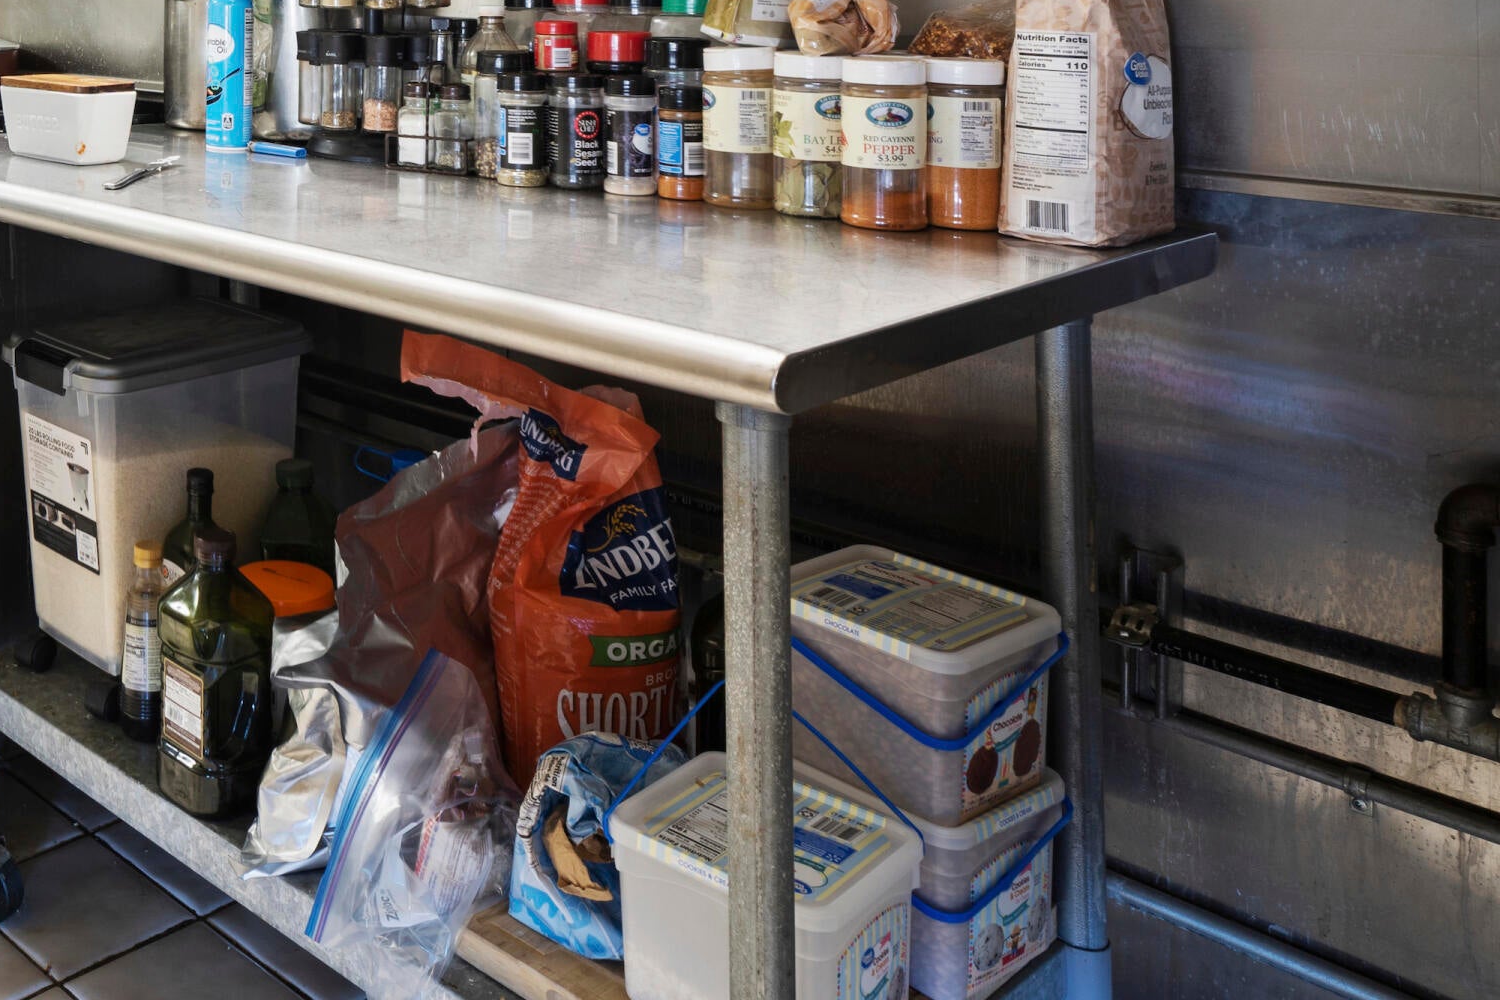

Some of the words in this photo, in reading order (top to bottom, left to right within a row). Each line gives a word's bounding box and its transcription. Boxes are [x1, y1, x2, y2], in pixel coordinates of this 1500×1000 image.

[1016, 33, 1056, 43] Nutrition
[1058, 35, 1088, 44] Facts
[1017, 60, 1046, 68] Calories
[1066, 61, 1088, 70] 110
[574, 139, 599, 149] Black
[803, 134, 826, 146] BAY
[863, 134, 879, 143] RED
[880, 135, 916, 143] CAYENNE
[863, 143, 916, 155] PEPPER
[574, 158, 597, 167] Seed
[42, 432, 61, 446] ROLLING
[61, 439, 75, 453] FOOD
[610, 584, 657, 604] FAMILY
[824, 618, 860, 637] CHOCOLATE
[606, 634, 677, 662] ORGA
[556, 684, 667, 740] SHORT
[992, 712, 1023, 732] Chocolate
